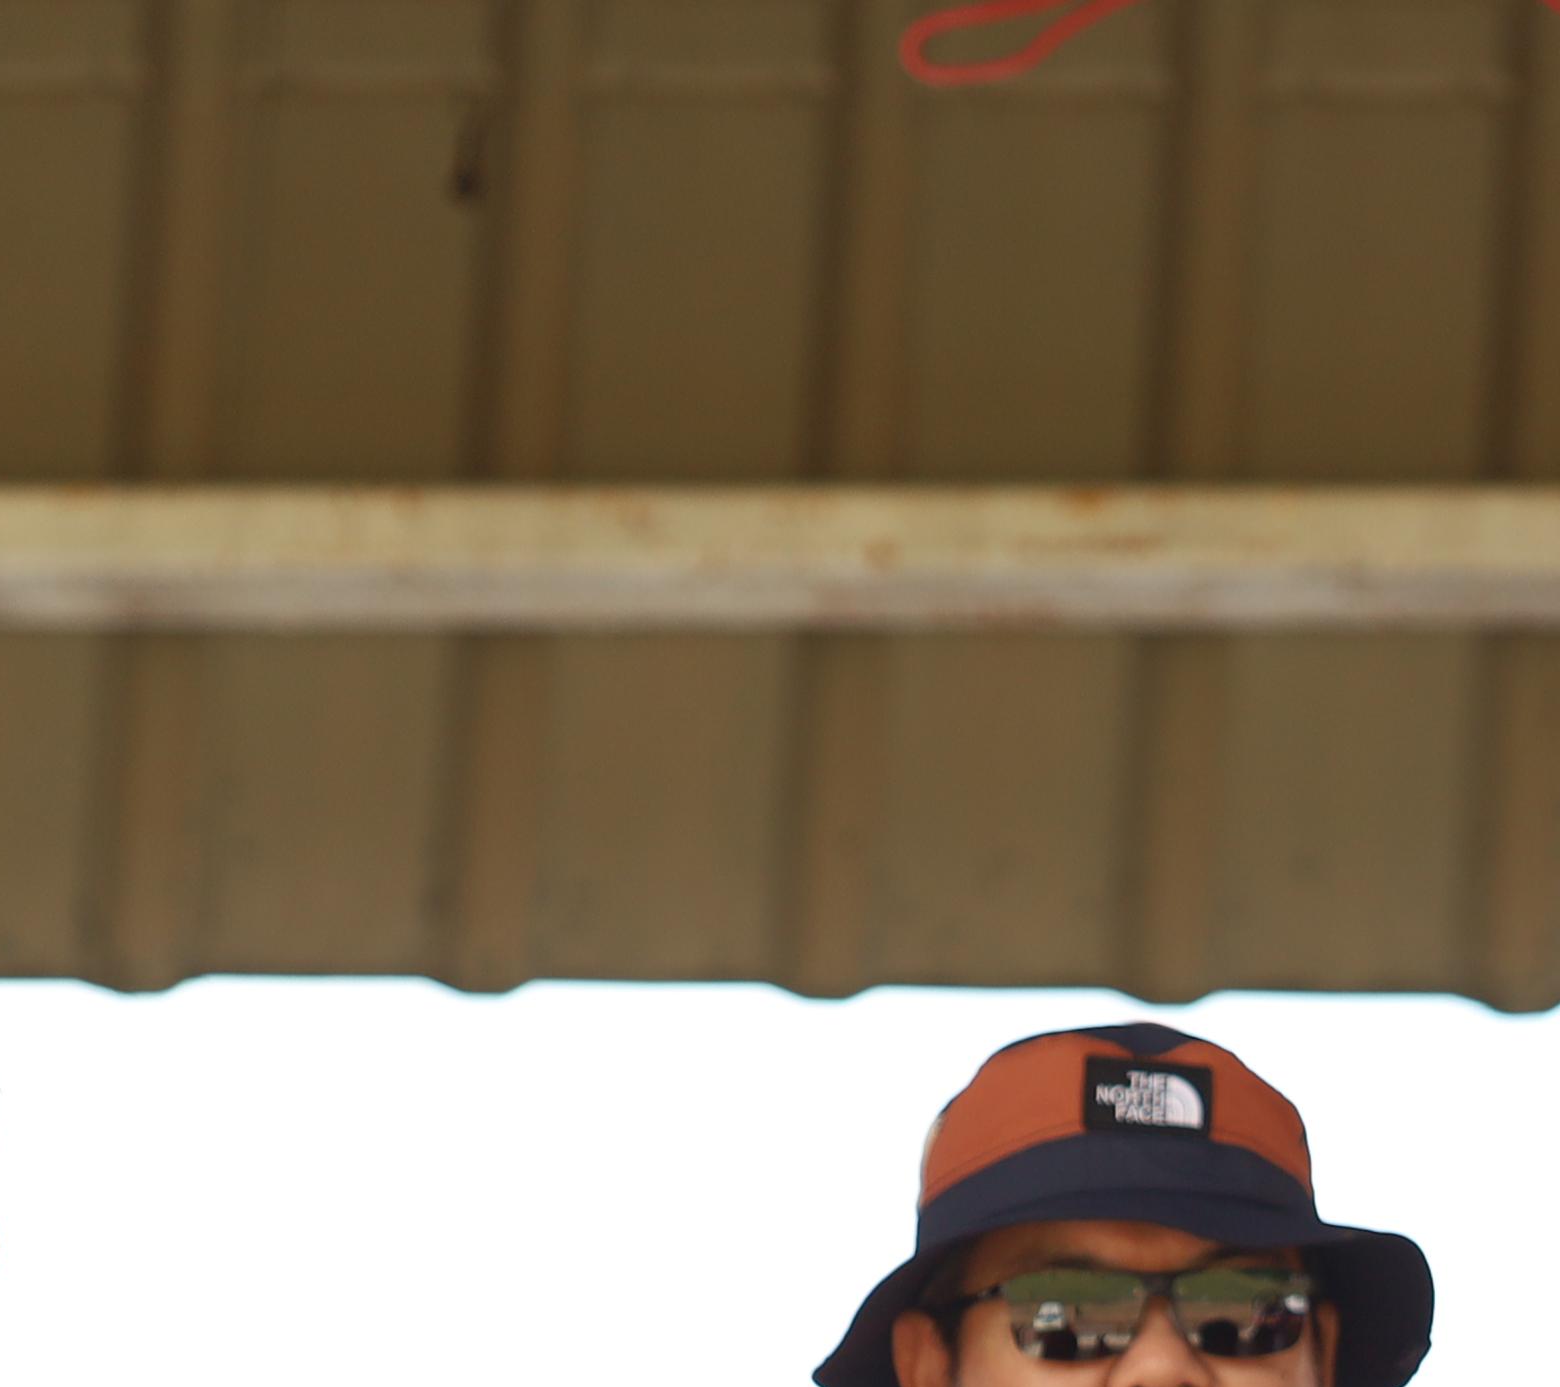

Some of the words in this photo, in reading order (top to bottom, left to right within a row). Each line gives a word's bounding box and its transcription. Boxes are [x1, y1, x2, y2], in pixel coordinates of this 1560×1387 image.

[1127, 1070, 1167, 1090] THE
[1095, 1083, 1166, 1106] NORTH
[1114, 1103, 1167, 1125] FACE
